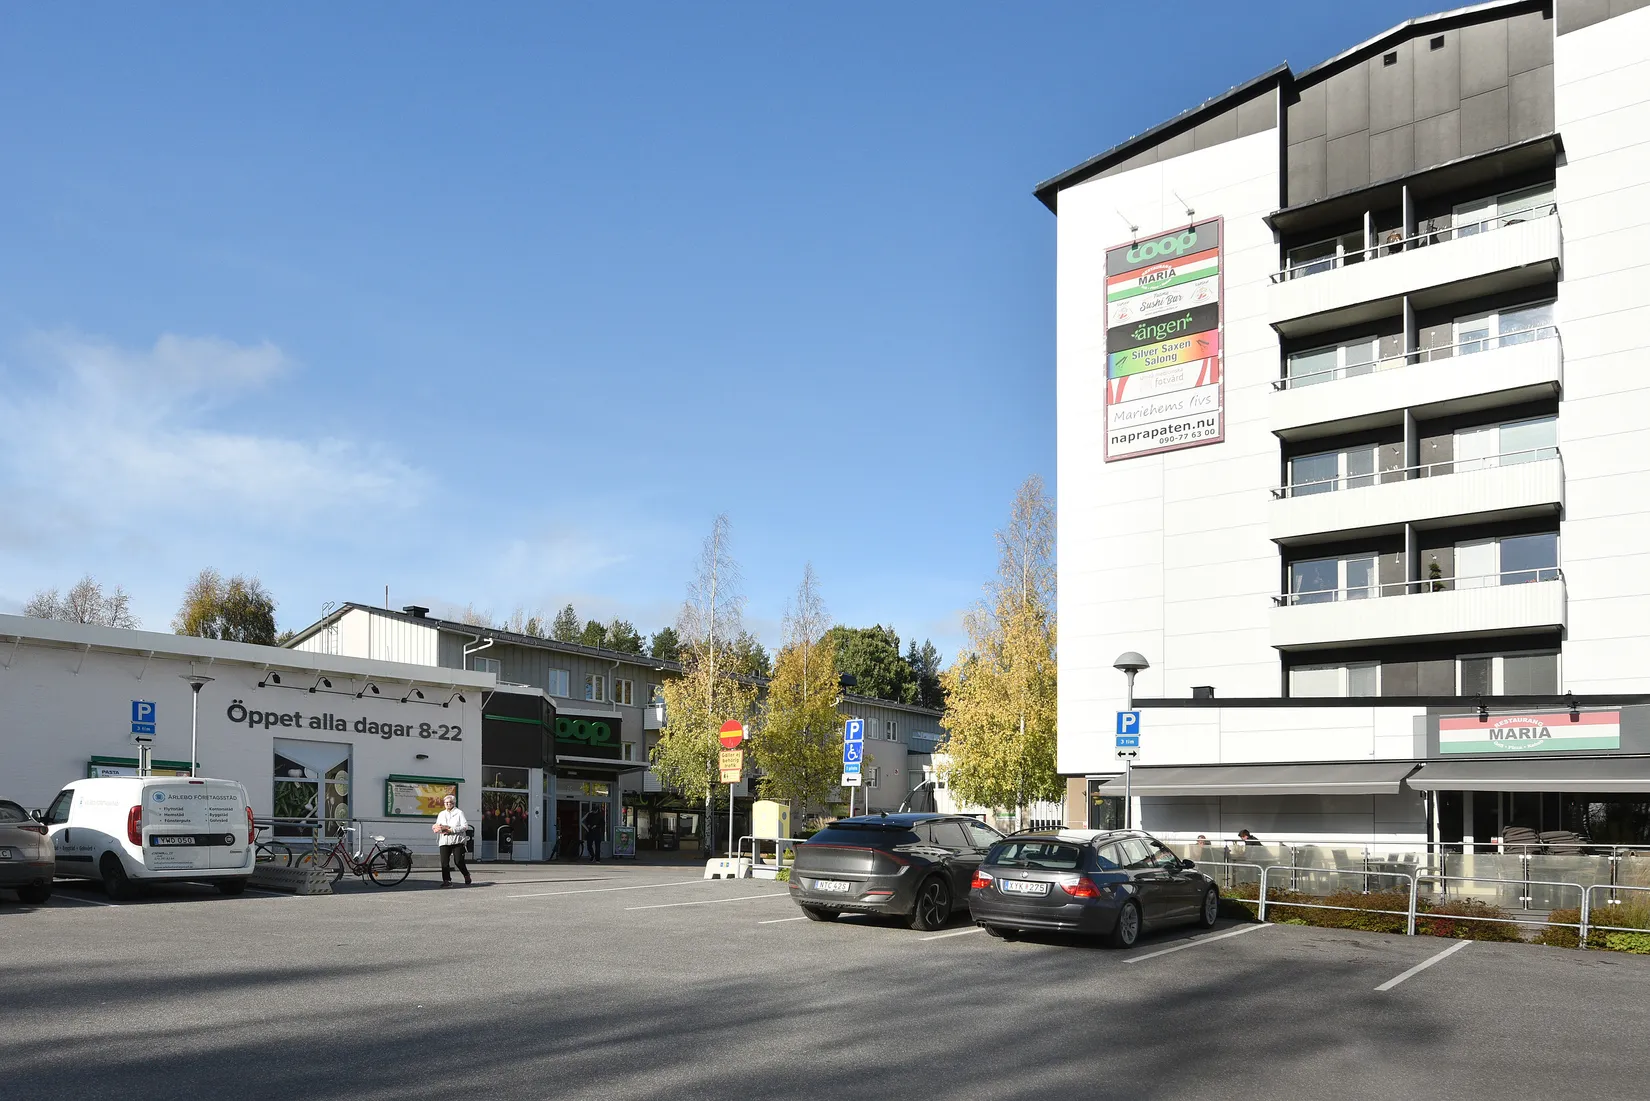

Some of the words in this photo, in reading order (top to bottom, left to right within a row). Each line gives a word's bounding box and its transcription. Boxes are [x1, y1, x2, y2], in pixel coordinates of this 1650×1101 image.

[1126, 230, 1198, 264] coop
[1138, 269, 1176, 286] MARIA
[1140, 299, 1165, 312] Sushi
[1166, 293, 1183, 305] Bar
[1137, 317, 1187, 340] ängen
[1132, 347, 1159, 360] Silver
[1161, 340, 1191, 353] Saxen
[1144, 353, 1178, 367] Salong
[1114, 401, 1184, 423] Mariehems
[1189, 394, 1212, 408] livs
[1111, 418, 1215, 445] naprapaten.nu
[1159, 433, 1189, 444] 090-77
[1191, 430, 1202, 439] 63
[1204, 428, 1216, 437] 00
[138, 703, 152, 721] P
[226, 699, 303, 729] Öppet
[308, 713, 347, 731] alla
[354, 717, 413, 740] dagar
[418, 722, 463, 742] 8-22
[556, 717, 611, 746] oop
[850, 722, 860, 740] P
[1122, 713, 1137, 733] P
[1494, 717, 1544, 728] RESTAURANG
[1489, 727, 1552, 740] MARIA
[820, 881, 832, 889] NTC
[1010, 882, 1023, 890] XYK
[1029, 883, 1045, 892] 275
